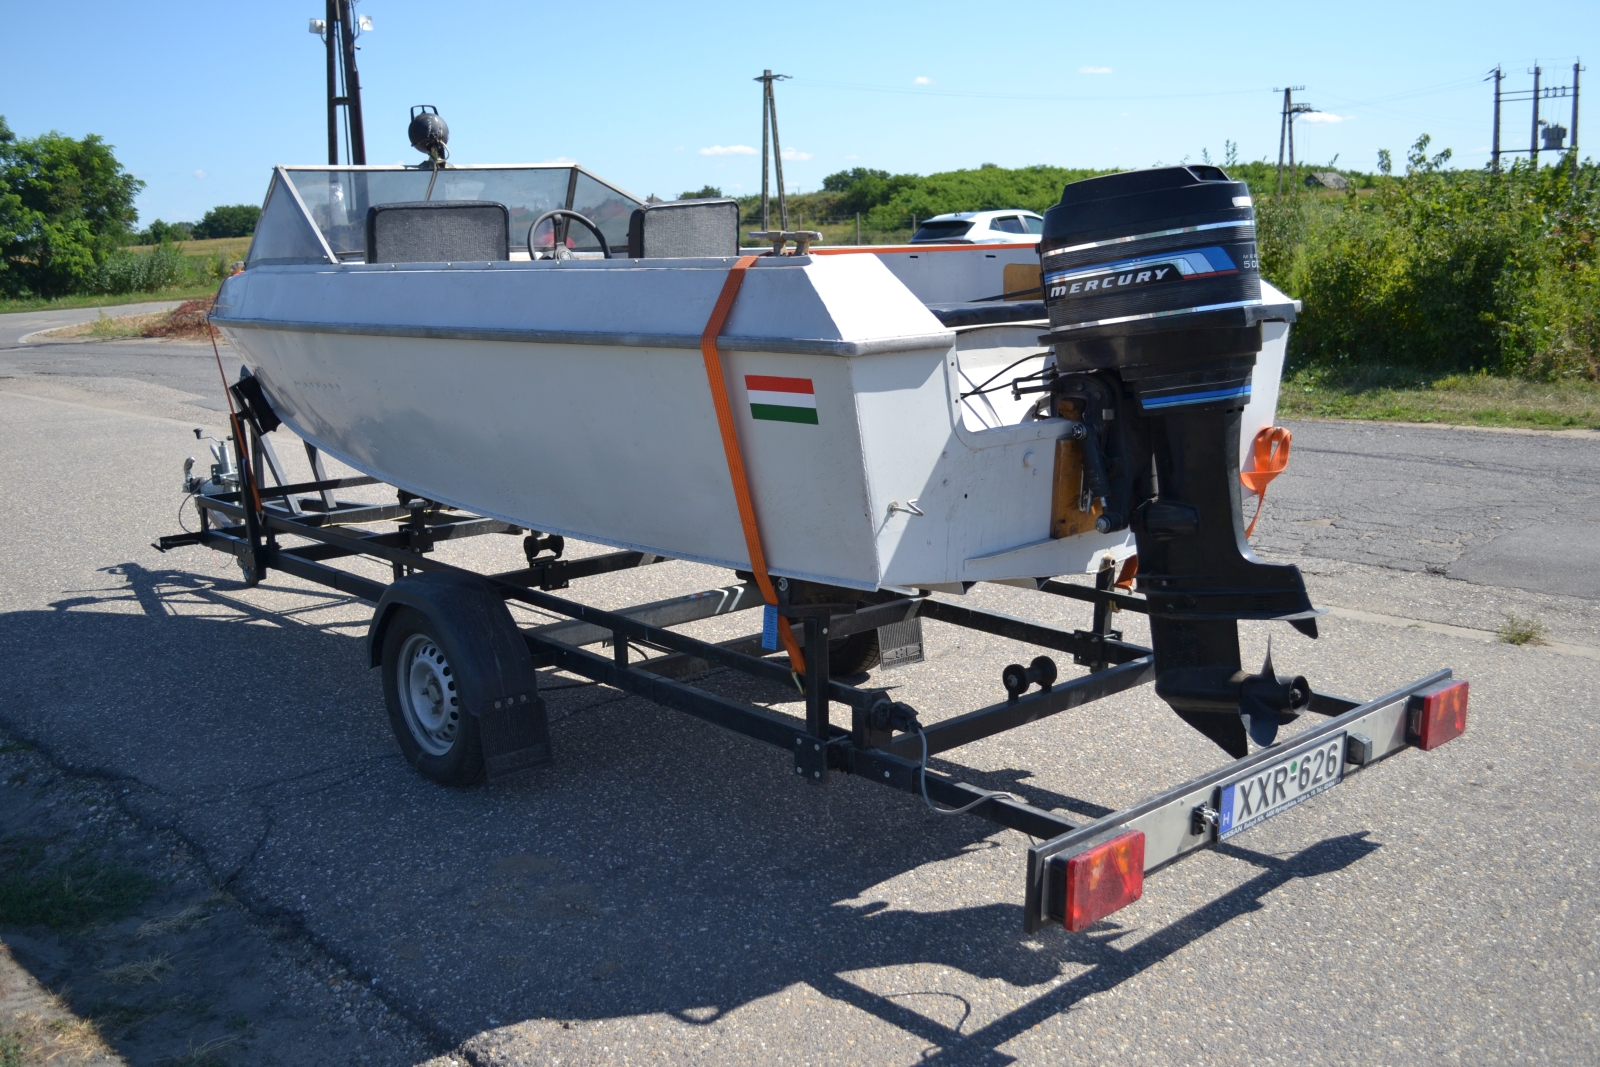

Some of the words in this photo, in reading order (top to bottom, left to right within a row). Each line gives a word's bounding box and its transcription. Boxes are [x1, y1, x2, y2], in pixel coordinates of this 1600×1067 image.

[1050, 267, 1170, 299] MERCURY
[1237, 742, 1338, 822] XXR-626
[1222, 811, 1230, 826] H
[1220, 826, 1243, 841] NISSAN
